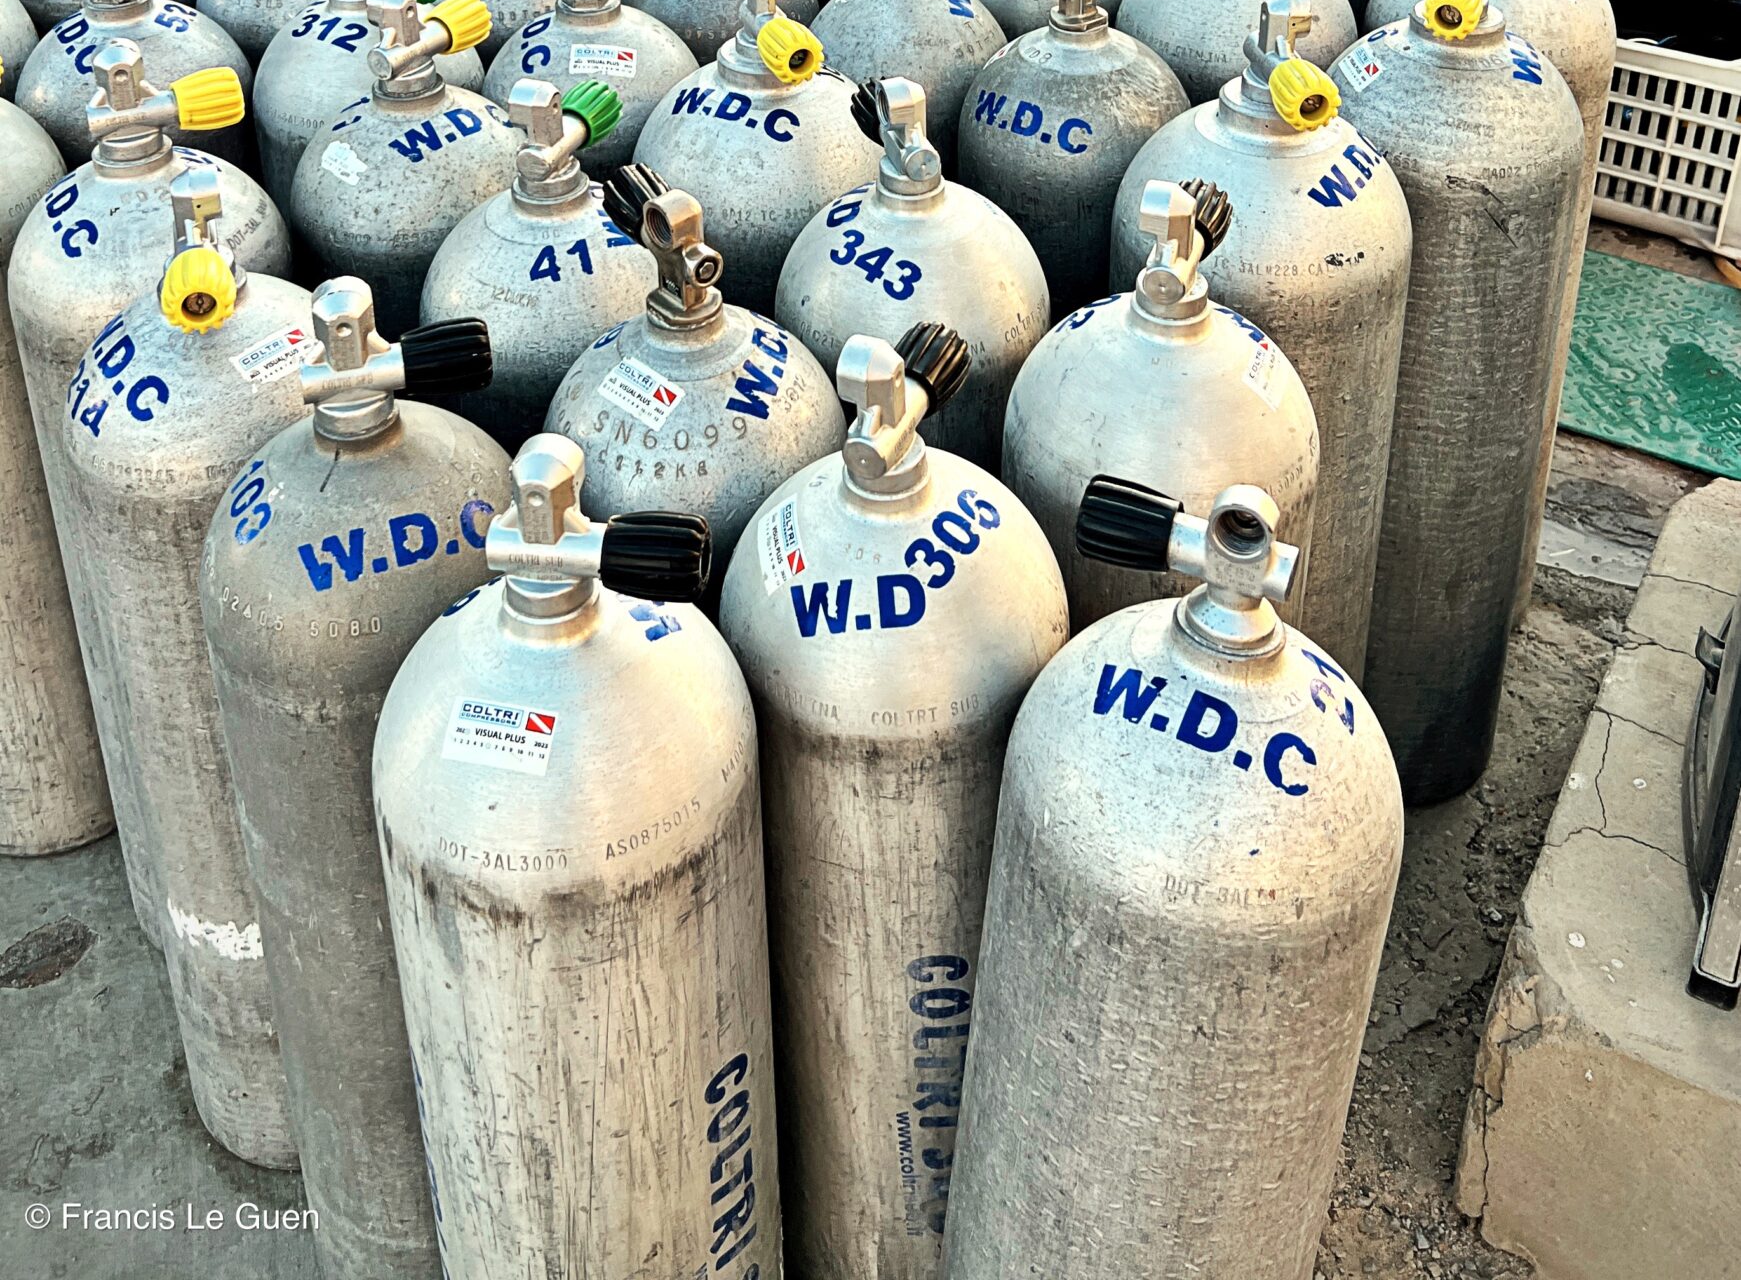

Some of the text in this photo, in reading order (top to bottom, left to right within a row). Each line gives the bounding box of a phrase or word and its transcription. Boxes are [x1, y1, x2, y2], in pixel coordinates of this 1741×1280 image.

[291, 12, 369, 54] 312
[671, 87, 801, 143] W.D.C
[974, 89, 1094, 155] W.D.C
[1307, 132, 1386, 208] W.D.
[529, 238, 594, 282] 41
[829, 230, 922, 301] 343
[241, 339, 284, 366] COLTRI
[619, 362, 654, 388] COLTRI
[725, 310, 789, 420] W.D.
[618, 382, 637, 398] VISUAL
[635, 393, 652, 407] PLUS
[297, 499, 495, 592] W.D.C
[785, 503, 796, 546] COLTRI
[905, 489, 1001, 589] 306
[790, 573, 927, 638] W.D
[455, 726, 470, 736] 202
[475, 727, 503, 740] VISUAL
[504, 733, 526, 744] PLUS
[462, 703, 520, 720] COLTRI
[1092, 662, 1318, 797] W.D.C
[438, 836, 568, 872] DOT-3AL3000
[704, 1052, 758, 1271] COLTRI
